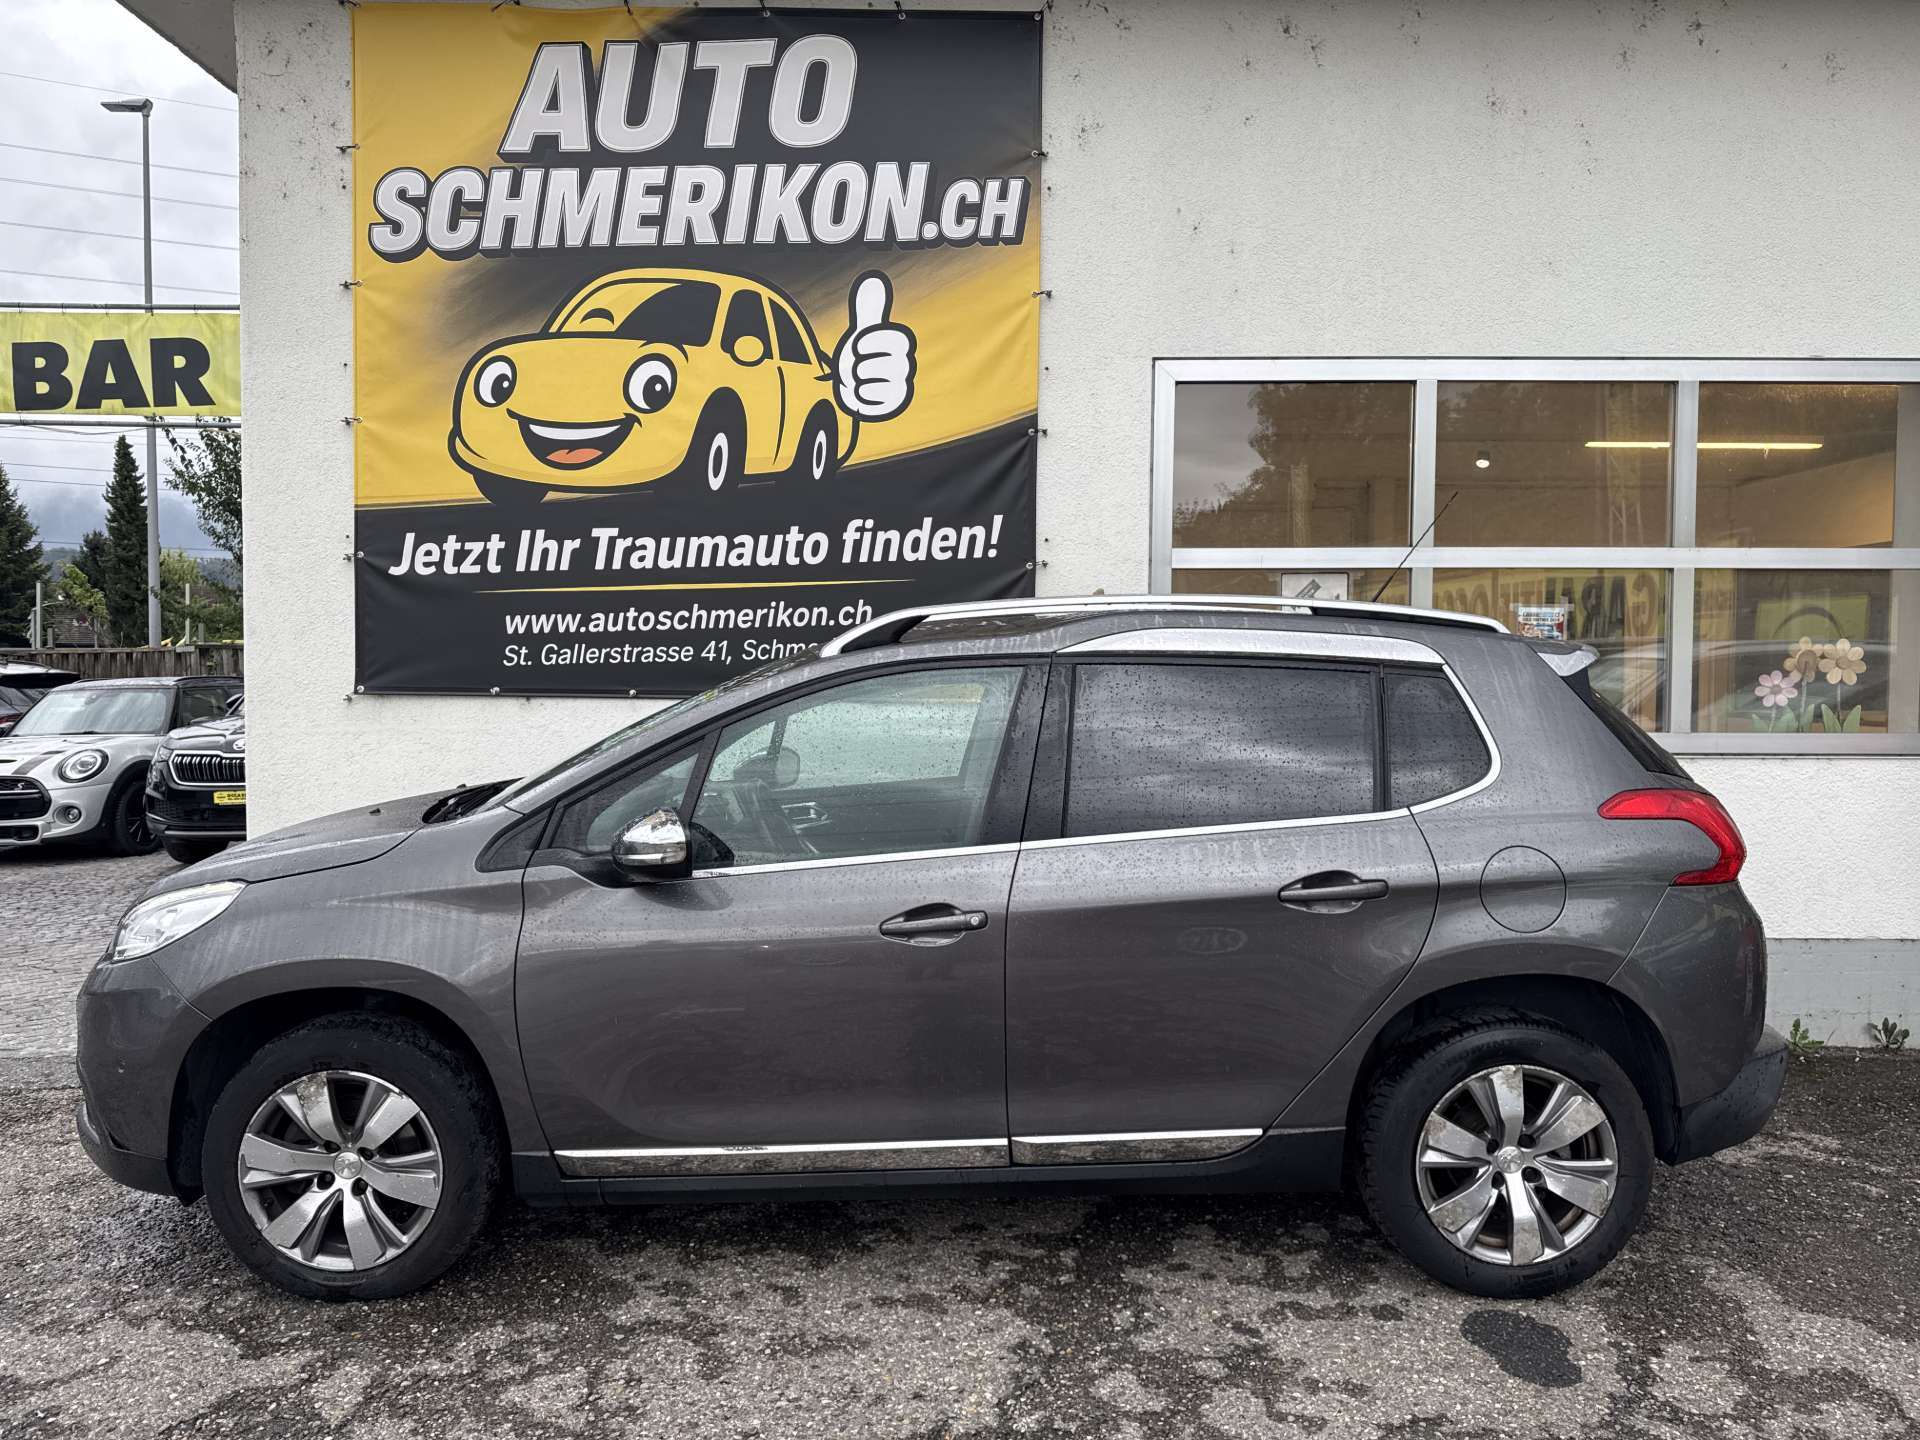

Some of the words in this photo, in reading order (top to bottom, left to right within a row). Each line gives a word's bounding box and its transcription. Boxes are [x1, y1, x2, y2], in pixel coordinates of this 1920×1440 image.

[502, 34, 858, 154] AUTO
[369, 161, 1026, 253] SCHMERIKON.CH
[12, 337, 216, 411] BAR
[388, 532, 504, 576] Jetzt
[515, 528, 580, 571] Ihr
[589, 524, 828, 570] Traumauto
[841, 514, 1003, 564] finden!
[505, 599, 872, 634] www.autoschmerikon.ch
[503, 645, 532, 666] St.
[540, 641, 694, 665] Gallerstrasse
[700, 640, 733, 665] 41,
